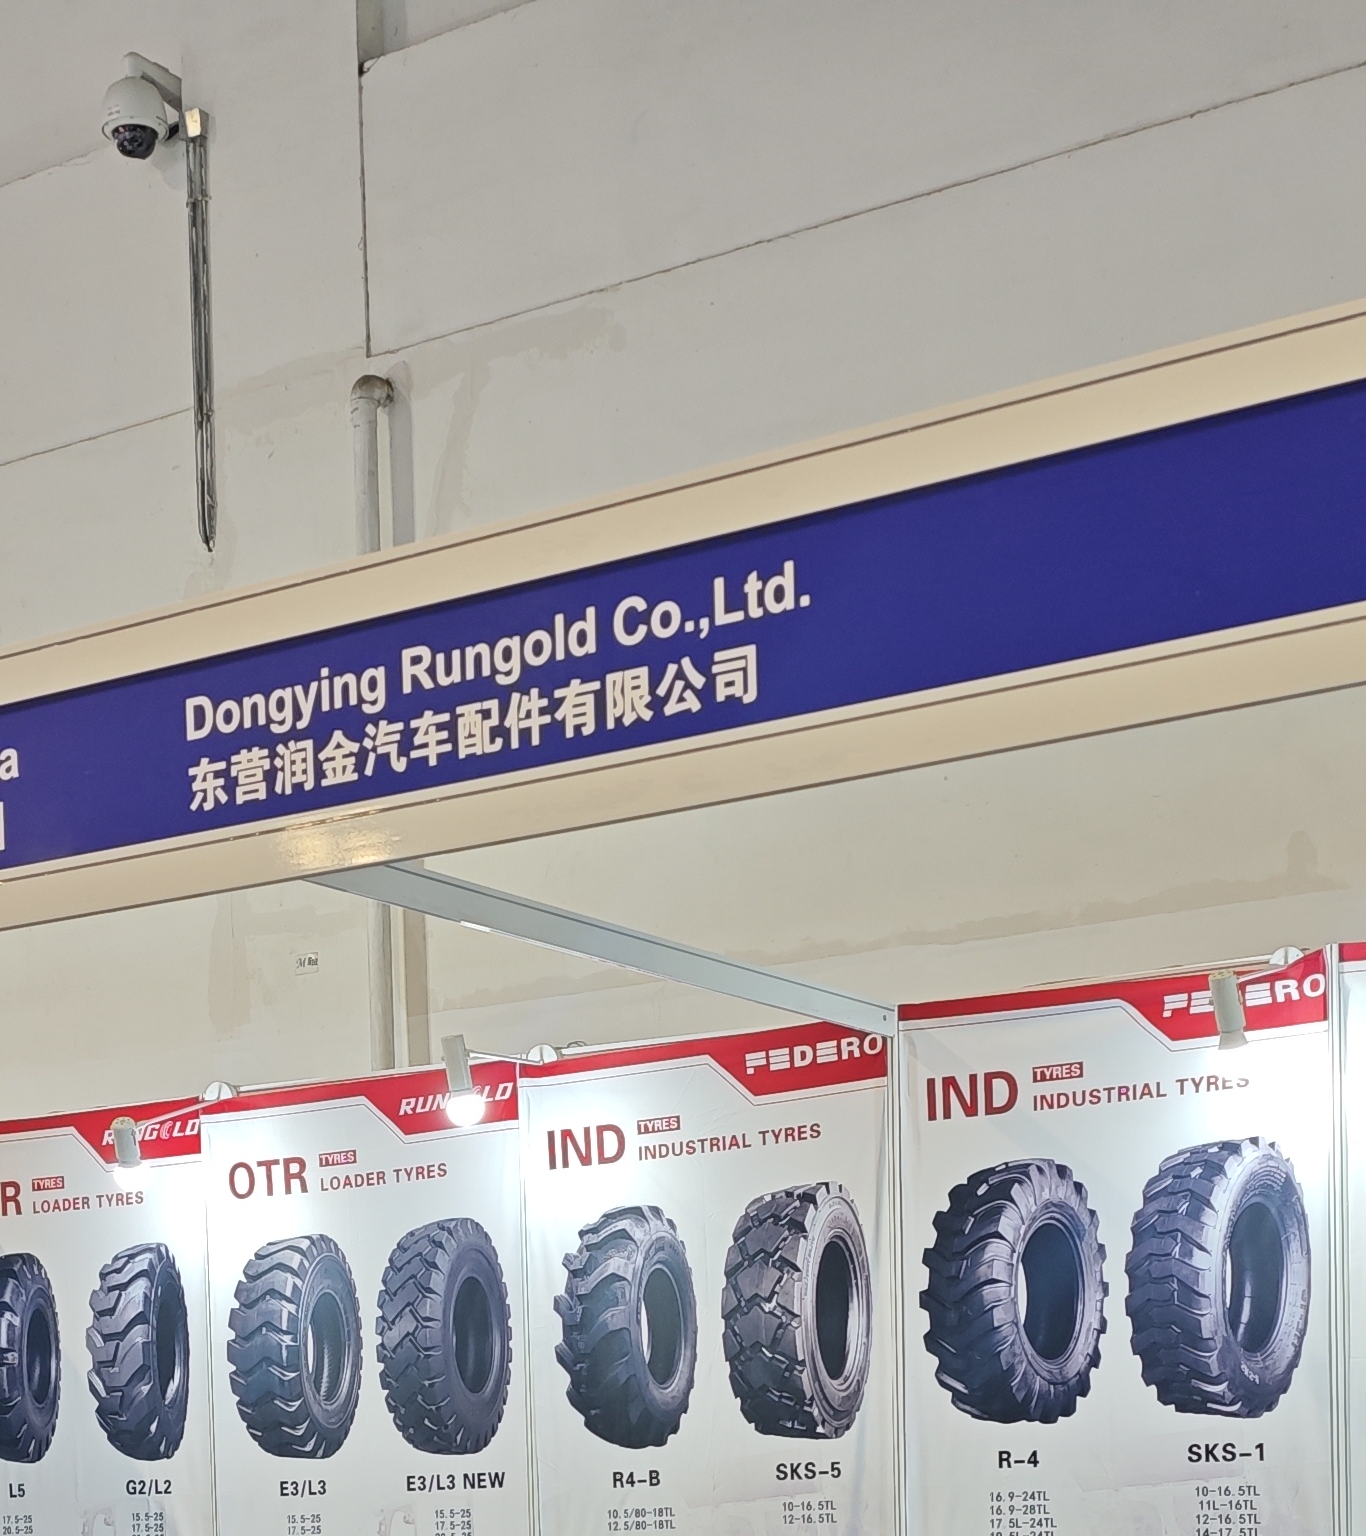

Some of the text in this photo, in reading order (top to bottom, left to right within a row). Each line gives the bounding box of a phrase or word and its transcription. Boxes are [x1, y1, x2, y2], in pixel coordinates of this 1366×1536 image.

[185, 560, 811, 742] Dongying Rungold Co.,Ltd.
[187, 643, 759, 812] 东营润金汽车配件有限公司
[1163, 973, 1325, 1017] FEERO
[745, 1034, 882, 1074] FEDERO
[1034, 1064, 1081, 1080] TYRES
[927, 1071, 1018, 1122] IND
[1033, 1083, 1166, 1112] INDUSTRIAL
[639, 1118, 678, 1132] TYRES
[547, 1124, 625, 1170] IND
[638, 1123, 821, 1161] INDUSTRIAL TYRES
[320, 1152, 355, 1165] TYRES
[33, 1178, 63, 1189] TYRES
[229, 1156, 308, 1200] OTR
[321, 1163, 447, 1191] LOADER TYRES
[33, 1192, 144, 1214] LOADER TYRES
[998, 1450, 1040, 1469] R-4
[1187, 1443, 1265, 1464] SKS-1
[612, 1470, 661, 1489] R4-B
[776, 1462, 841, 1481] SKS-5
[9, 1483, 25, 1498] L5
[126, 1479, 172, 1496] G2/L2
[280, 1480, 327, 1497] E3/L3
[406, 1472, 505, 1492] E3/L3 NEW
[1198, 1500, 1257, 1511] 11L-16TL
